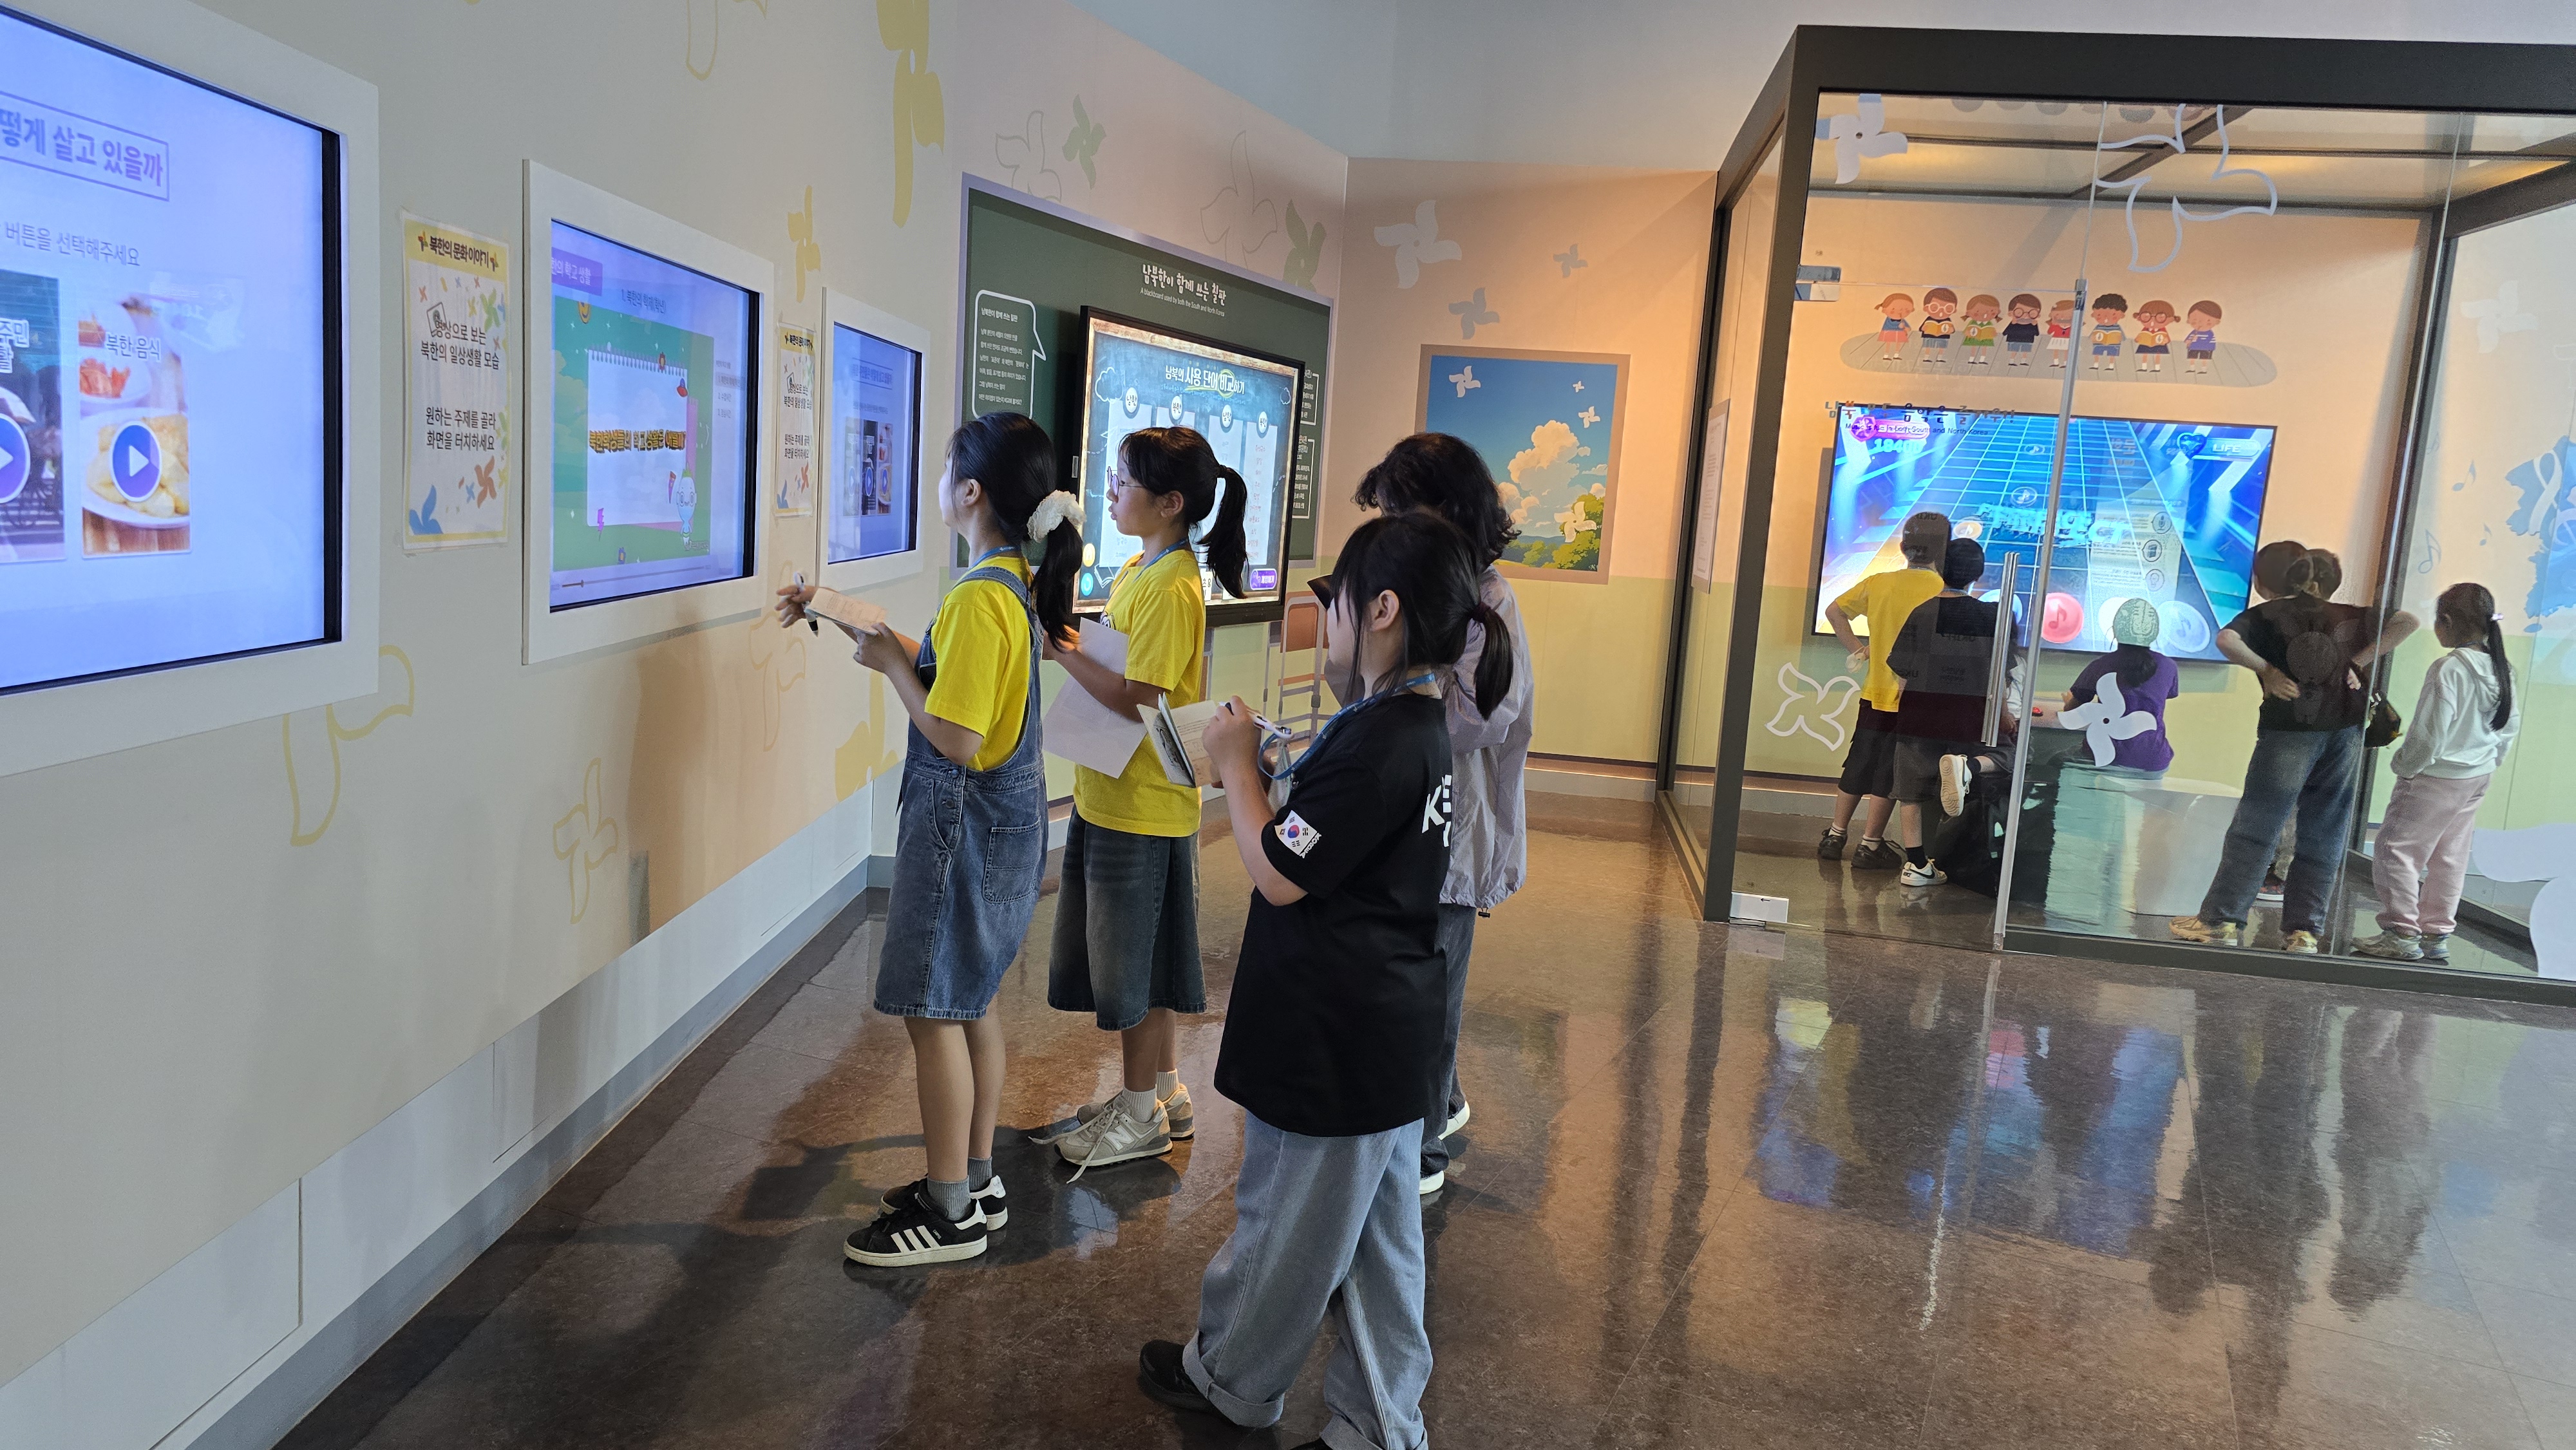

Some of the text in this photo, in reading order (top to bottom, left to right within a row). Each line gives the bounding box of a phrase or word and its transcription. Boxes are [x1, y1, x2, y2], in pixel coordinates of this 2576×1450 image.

[53, 125, 97, 165] 살고
[102, 140, 163, 187] 있을까
[4, 221, 140, 266] 버튼을 선택해주세요
[430, 235, 489, 269] 북한의 문화 이야기
[1142, 264, 1226, 306] 남북한이 함께 쓰는 칠판
[1144, 288, 1164, 299] blackboard
[1191, 301, 1200, 310] South
[1207, 306, 1215, 314] North
[1215, 308, 1225, 317] Korea
[435, 321, 486, 346] 영상으로 보는
[106, 333, 160, 361] 북한 음식
[421, 340, 500, 370] 북한의 일상생활 모습
[1165, 364, 1184, 382] 남북의
[1185, 366, 1202, 387] 사용
[1203, 369, 1218, 390] 단어
[1219, 373, 1245, 395] 비교하기
[1127, 393, 1137, 406] 남한
[1172, 401, 1182, 414] 북한
[426, 406, 497, 431] 원하는 주제를 골라
[1222, 410, 1232, 422] 남한
[1260, 416, 1268, 426] 북한
[1901, 402, 1949, 424] 음악은
[426, 429, 495, 452] 화면을 터치하세요
[2212, 444, 2241, 453] LIFE
[1299, 833, 1322, 859] KOREA
[933, 1229, 942, 1240] CAMPUS
